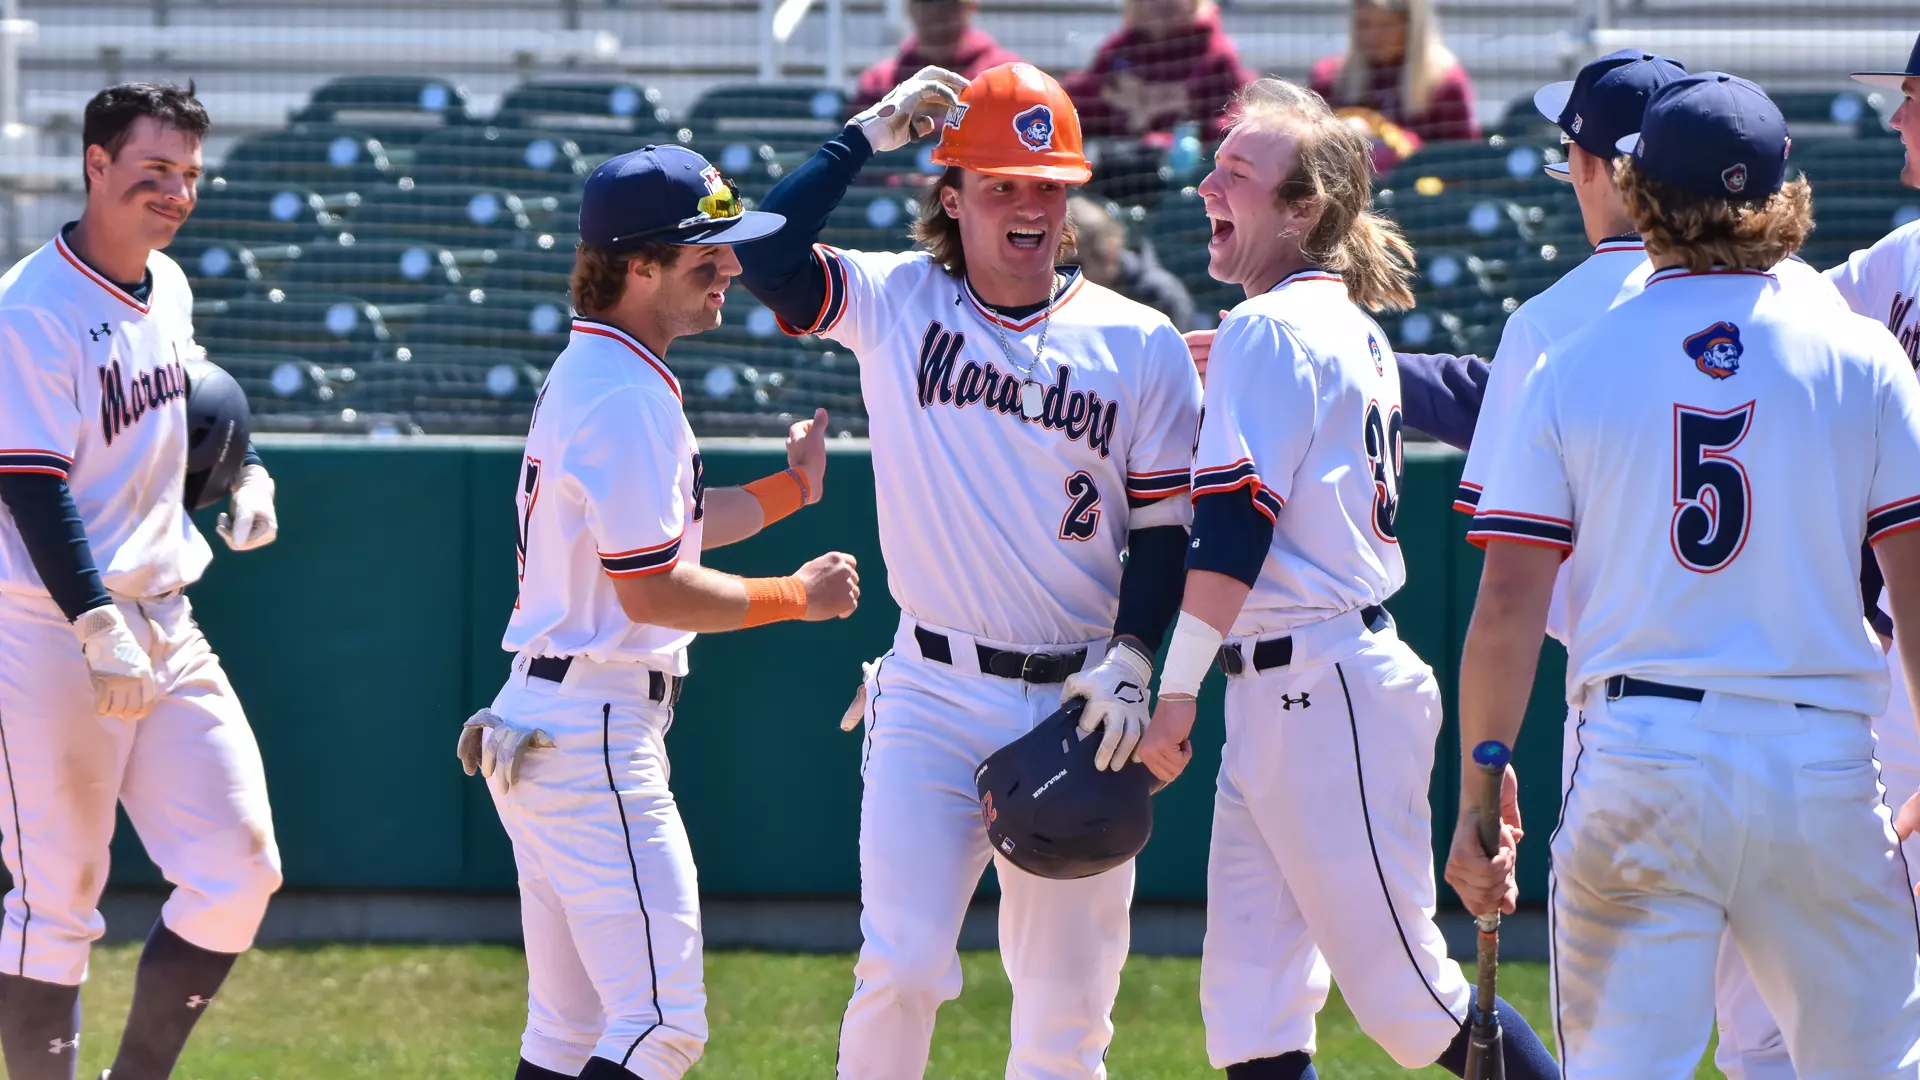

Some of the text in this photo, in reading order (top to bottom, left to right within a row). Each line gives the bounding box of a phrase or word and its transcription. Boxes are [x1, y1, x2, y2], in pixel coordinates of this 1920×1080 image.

[917, 319, 1118, 460] Maraders
[1059, 470, 1101, 542] 2
[1670, 399, 1756, 574] 5
